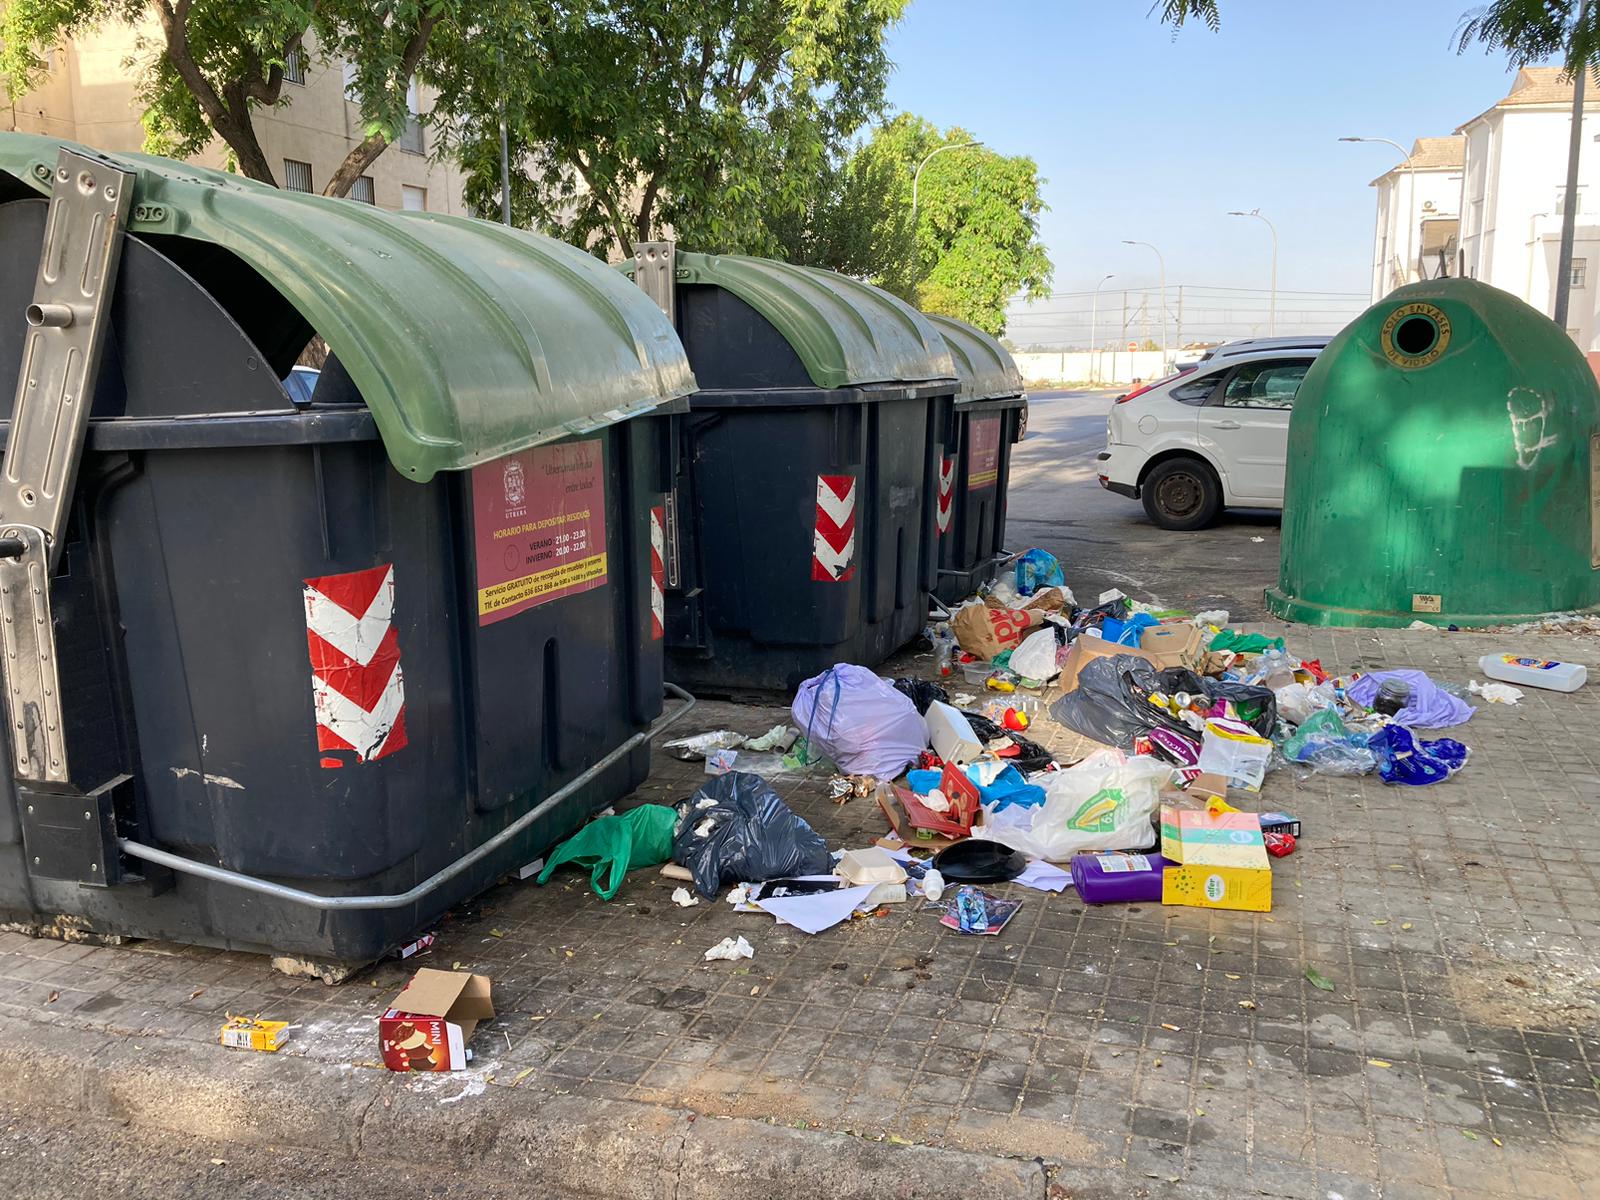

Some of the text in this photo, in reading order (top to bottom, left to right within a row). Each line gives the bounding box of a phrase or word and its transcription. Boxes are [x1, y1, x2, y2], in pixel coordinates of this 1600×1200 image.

[1383, 305, 1450, 336] SOLO ENVASES
[1387, 349, 1439, 366] DE VIDRIO
[493, 509, 591, 540] HORARIO PARA DEPOSITAR RESIDUOS
[529, 538, 553, 551] VERANO
[555, 533, 570, 545] 21.00
[572, 529, 586, 540] 23.00
[525, 550, 553, 565] INVIERNO
[485, 586, 507, 598] Servicio
[506, 577, 533, 592] GRATUITO
[533, 575, 540, 583] de
[540, 569, 560, 581] recogida
[493, 598, 501, 608] de
[501, 592, 524, 605] Contacto
[430, 1022, 441, 1044] MINI
